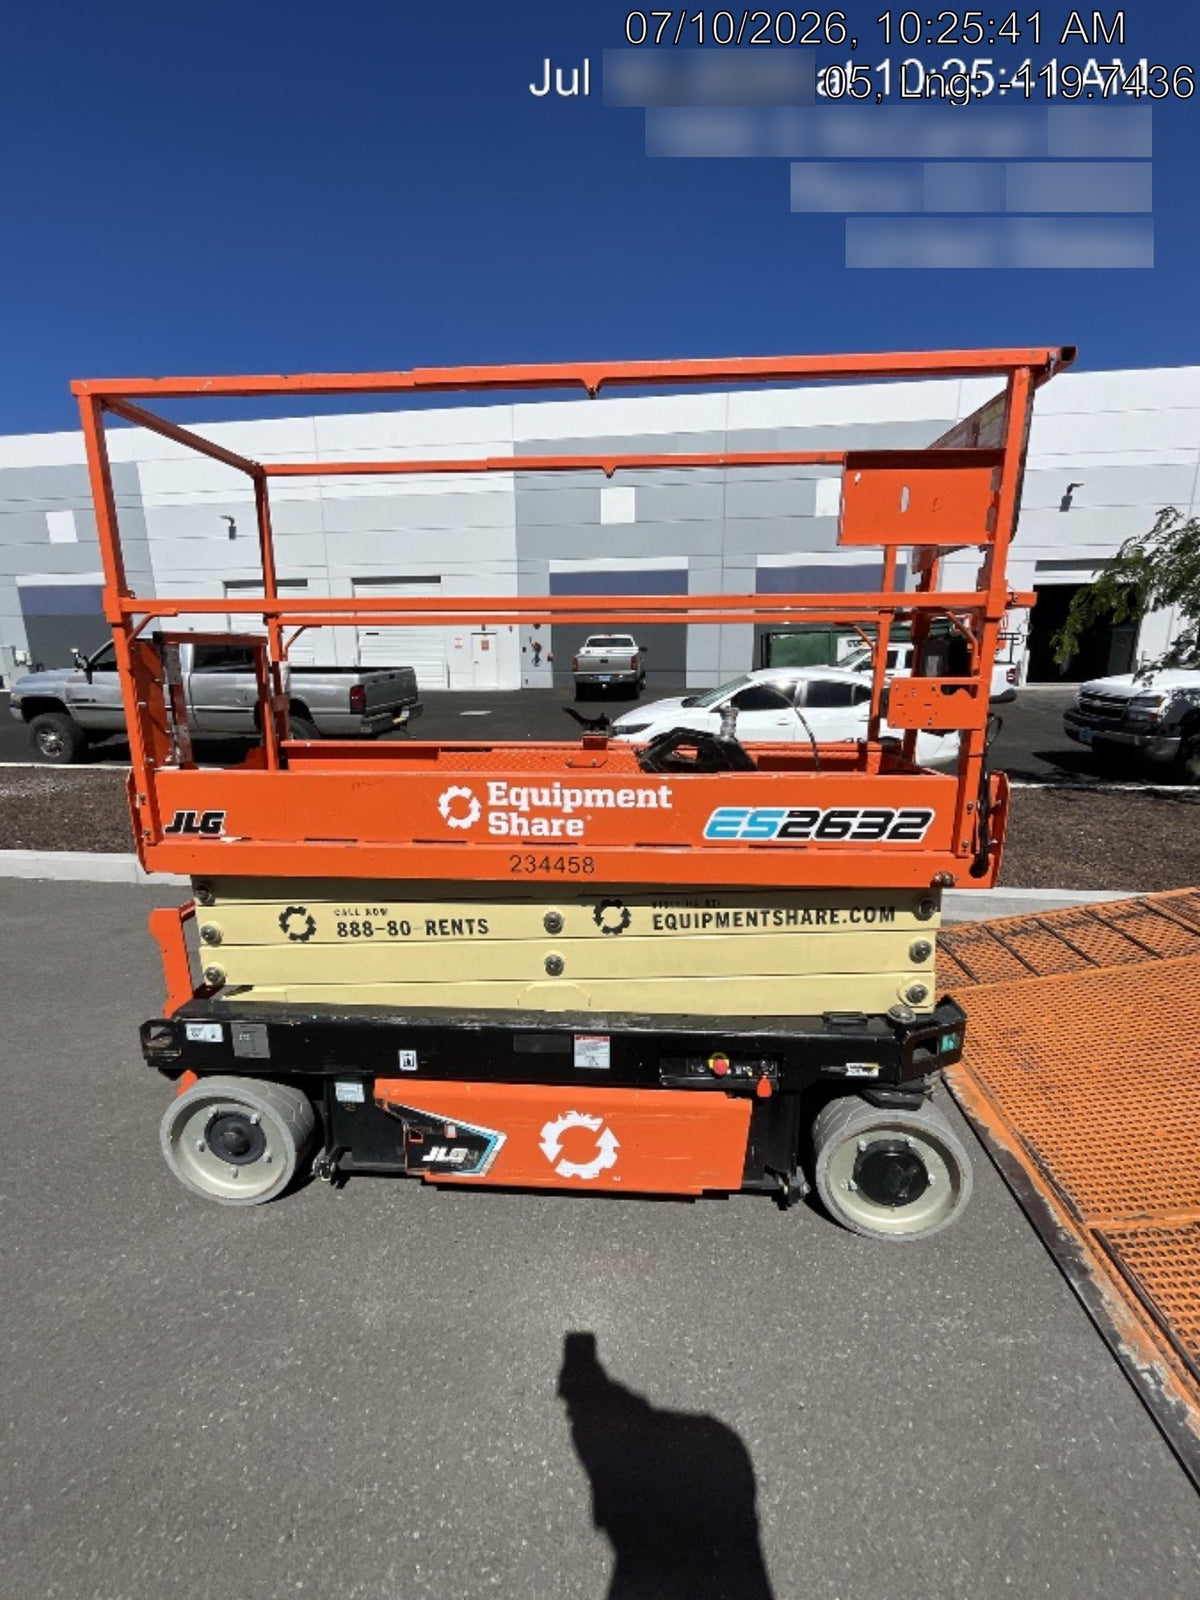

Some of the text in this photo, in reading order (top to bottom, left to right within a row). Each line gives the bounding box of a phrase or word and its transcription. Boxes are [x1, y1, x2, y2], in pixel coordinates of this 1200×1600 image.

[486, 781, 673, 813] Equipment
[164, 810, 227, 835] JLG
[488, 811, 584, 836] Share
[704, 808, 934, 841] ES2632
[509, 854, 595, 874] 234458
[425, 918, 489, 936] RENTS
[653, 906, 896, 930] EQUIPMENTSHARE.COM
